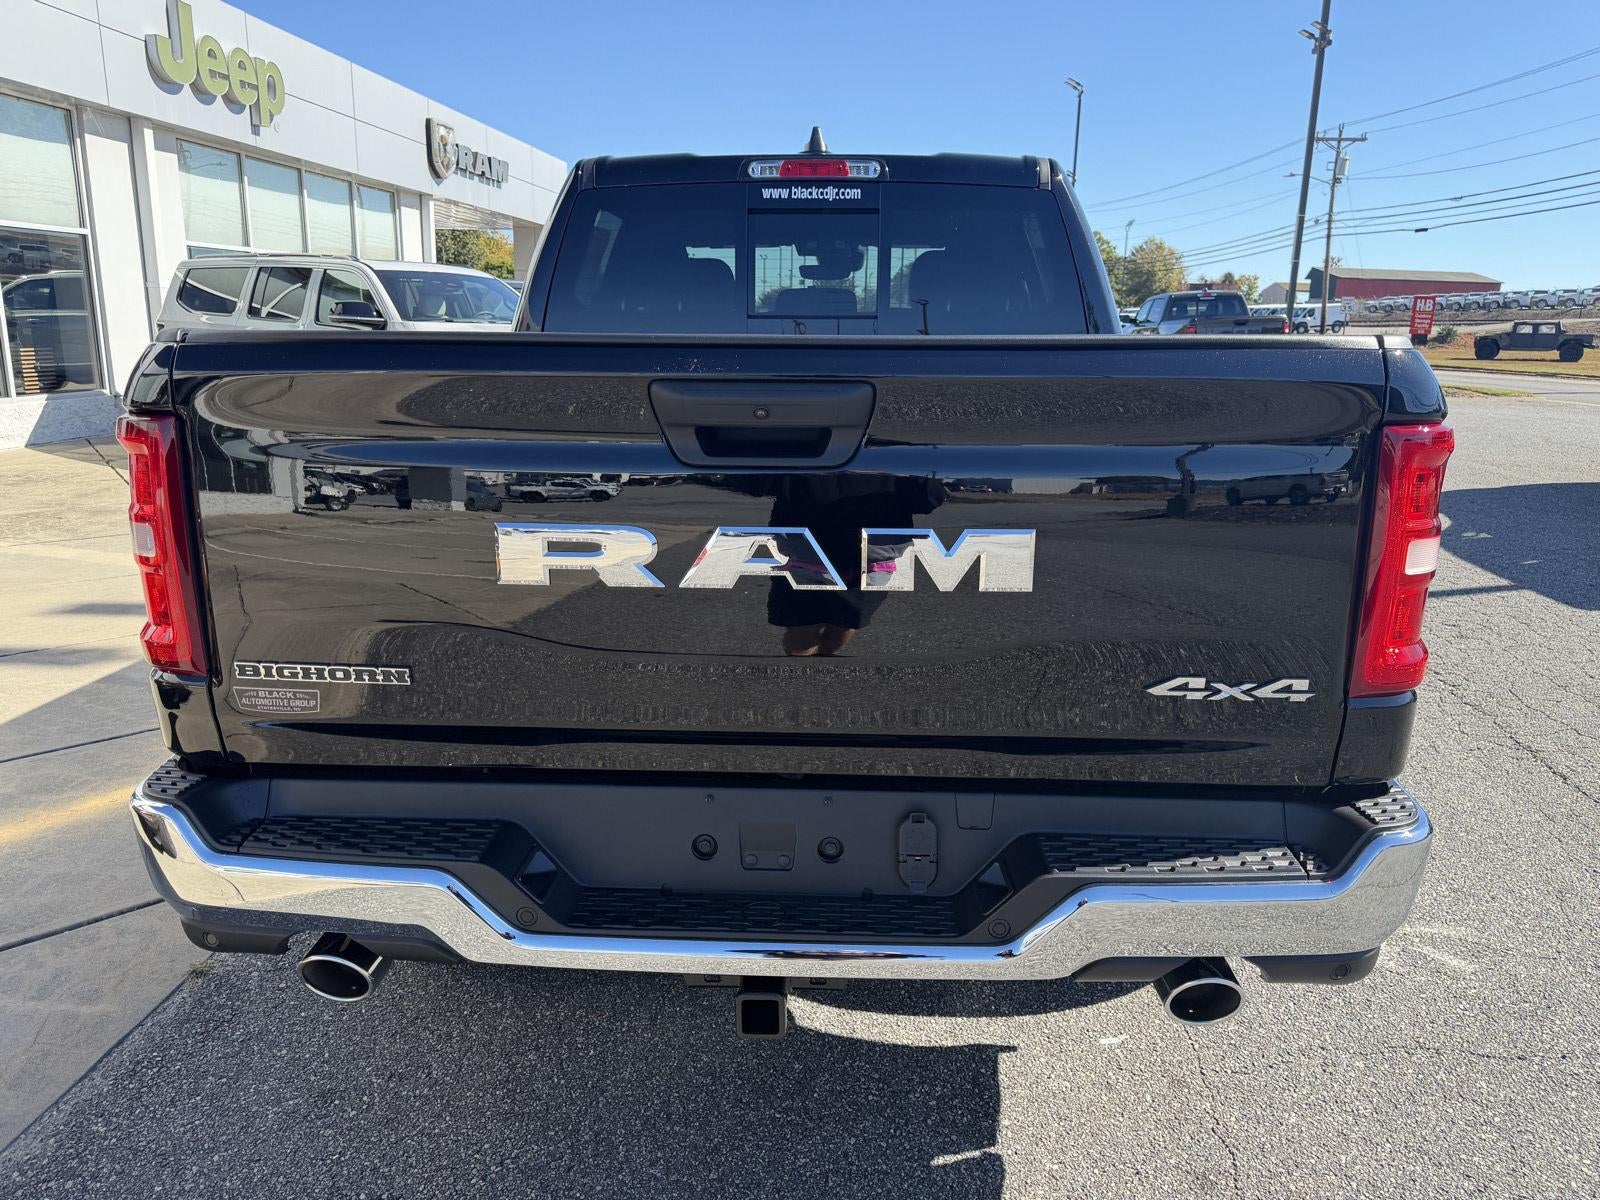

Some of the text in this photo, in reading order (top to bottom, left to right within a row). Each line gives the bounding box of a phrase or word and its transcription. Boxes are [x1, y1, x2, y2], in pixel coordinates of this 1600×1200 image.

[145, 0, 286, 128] Jeep
[455, 143, 509, 183] RAM
[762, 186, 861, 201] www blackcdjr.com
[495, 522, 1036, 592] RAM
[234, 661, 411, 685] BIGHORN
[241, 698, 289, 706] AUTOMOTIVE
[258, 690, 295, 699] BLACK
